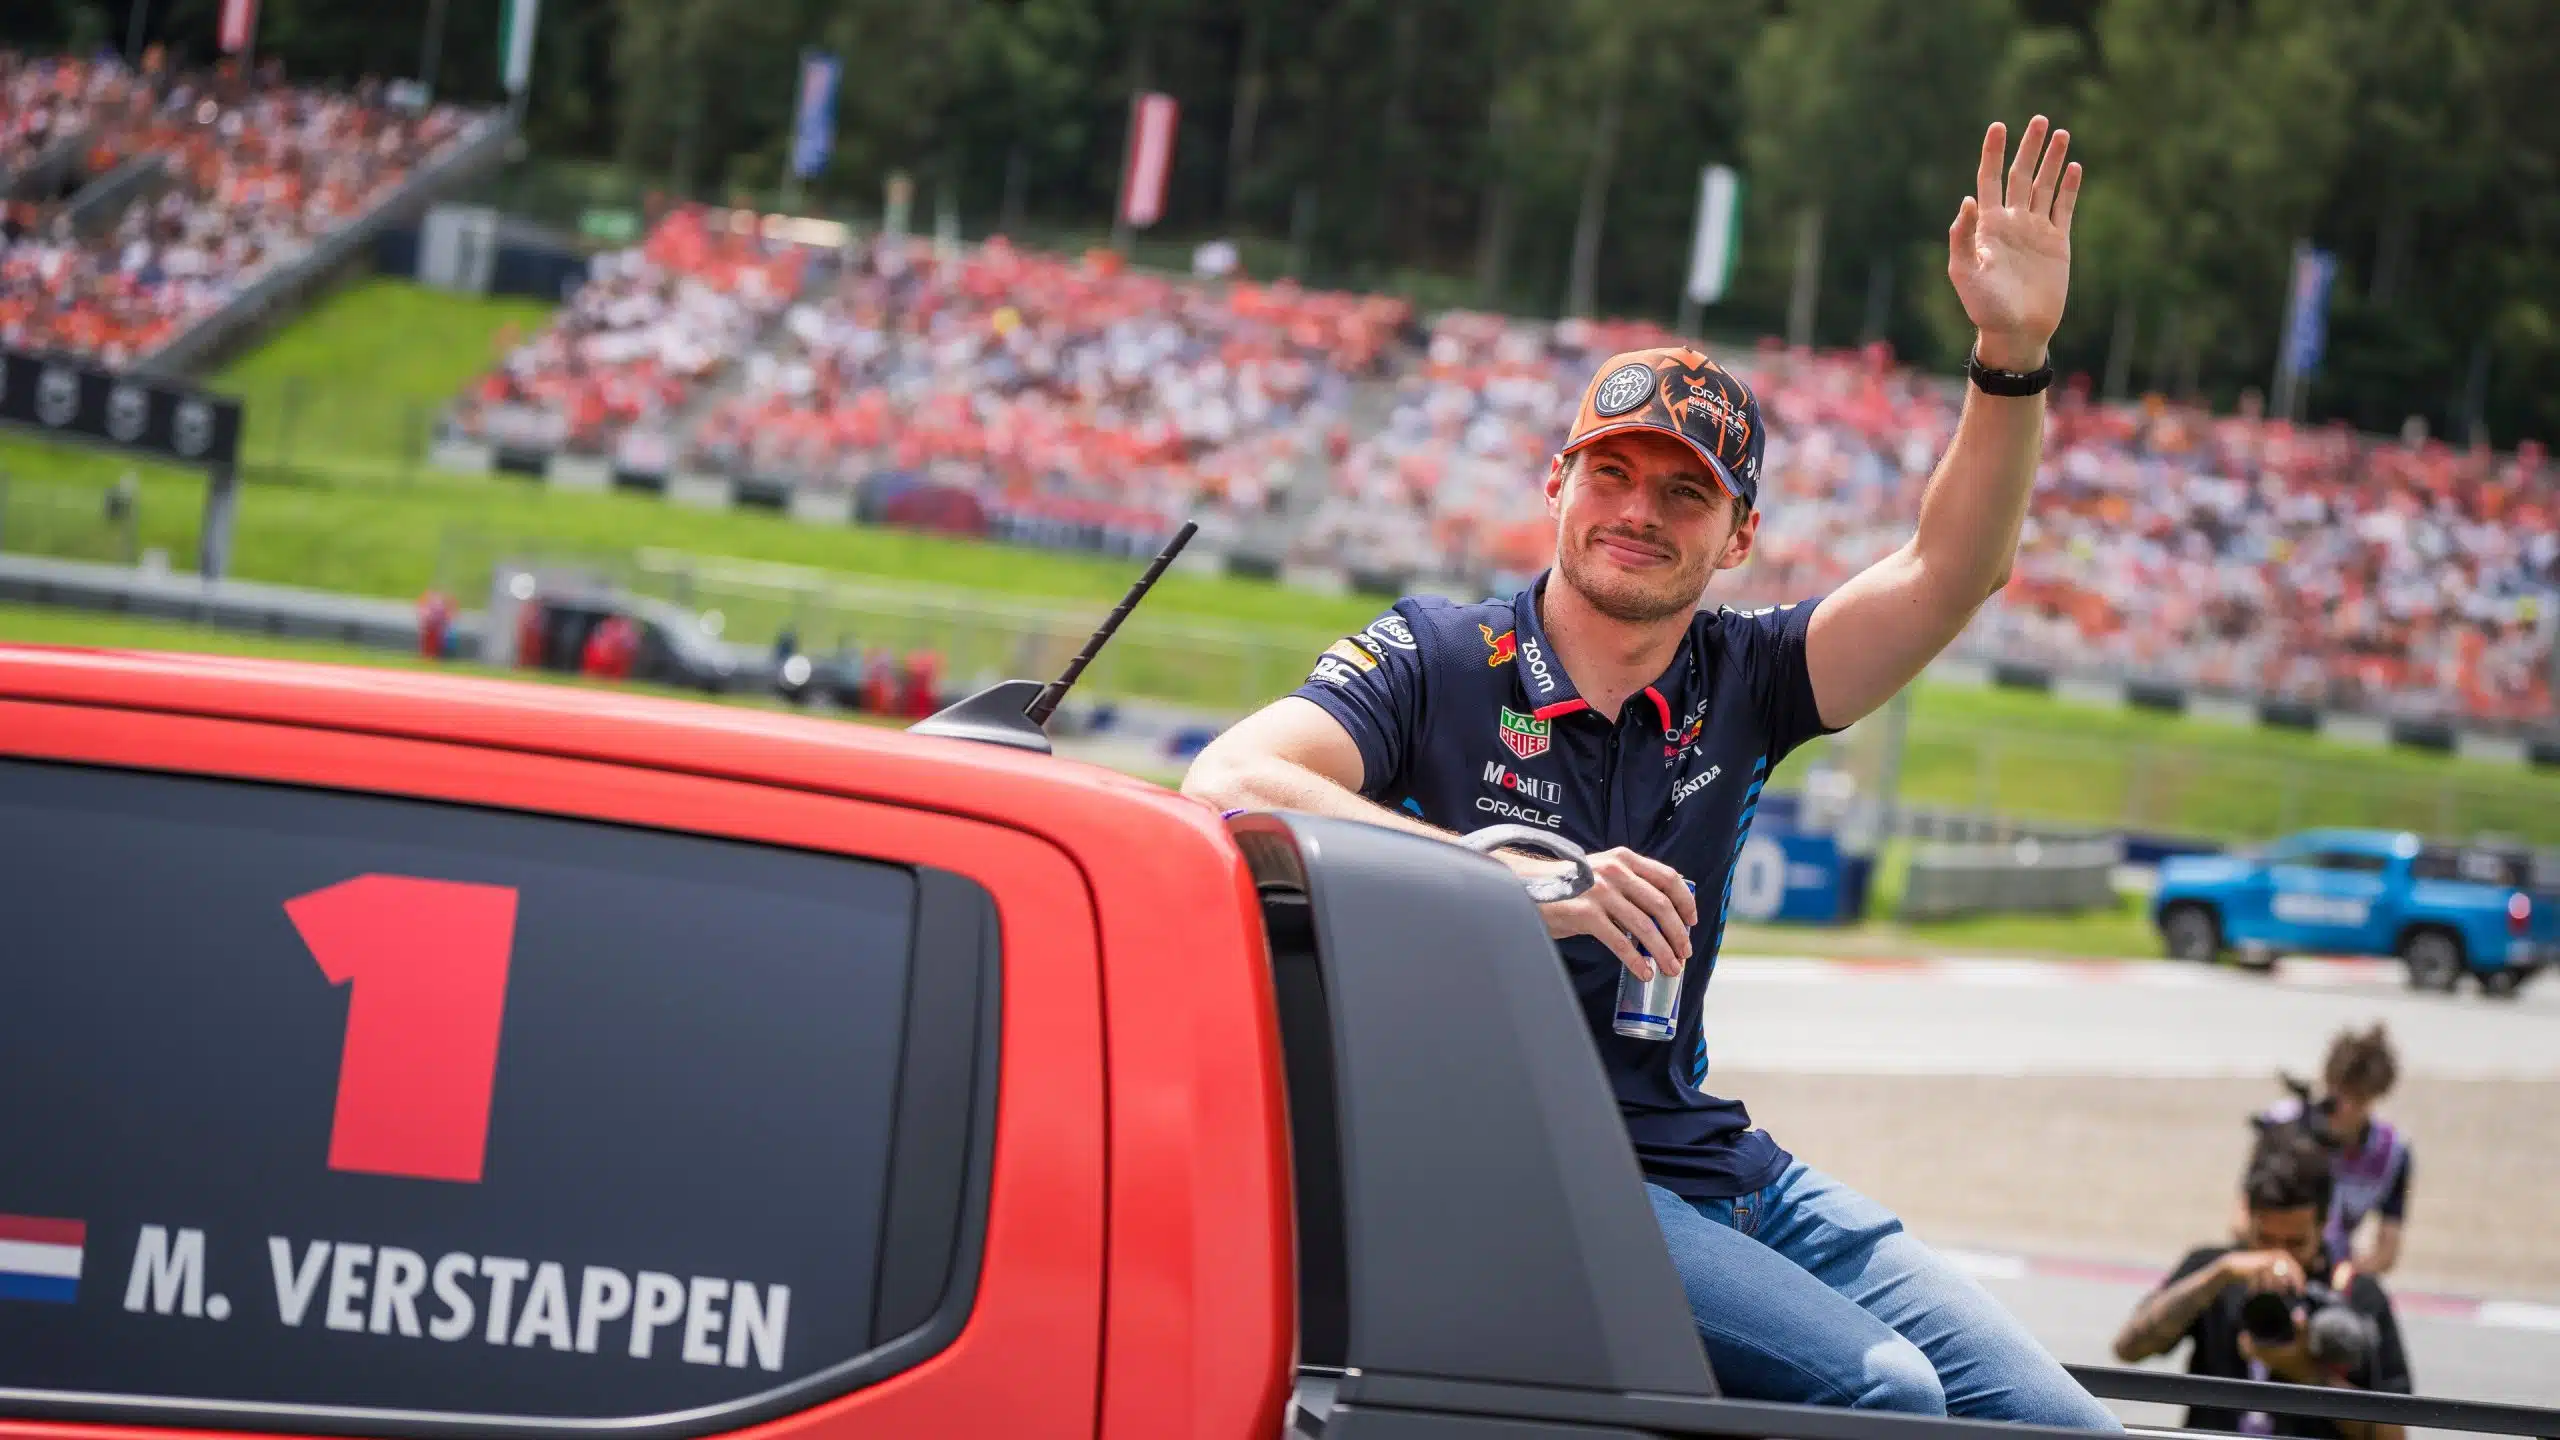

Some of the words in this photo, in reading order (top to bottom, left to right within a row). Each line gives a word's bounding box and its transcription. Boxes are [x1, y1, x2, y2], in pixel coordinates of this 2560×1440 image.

[1690, 385, 1746, 421] ORACLE
[1521, 636, 1555, 693] zoom
[1505, 711, 1545, 734] TAG
[1502, 728, 1546, 756] HEUER
[1483, 761, 1538, 797] Mobil
[1476, 797, 1562, 828] ORACLE
[283, 873, 518, 1183] 1
[124, 1225, 231, 1320] M.
[268, 1237, 791, 1372] VERSTAPPEN
